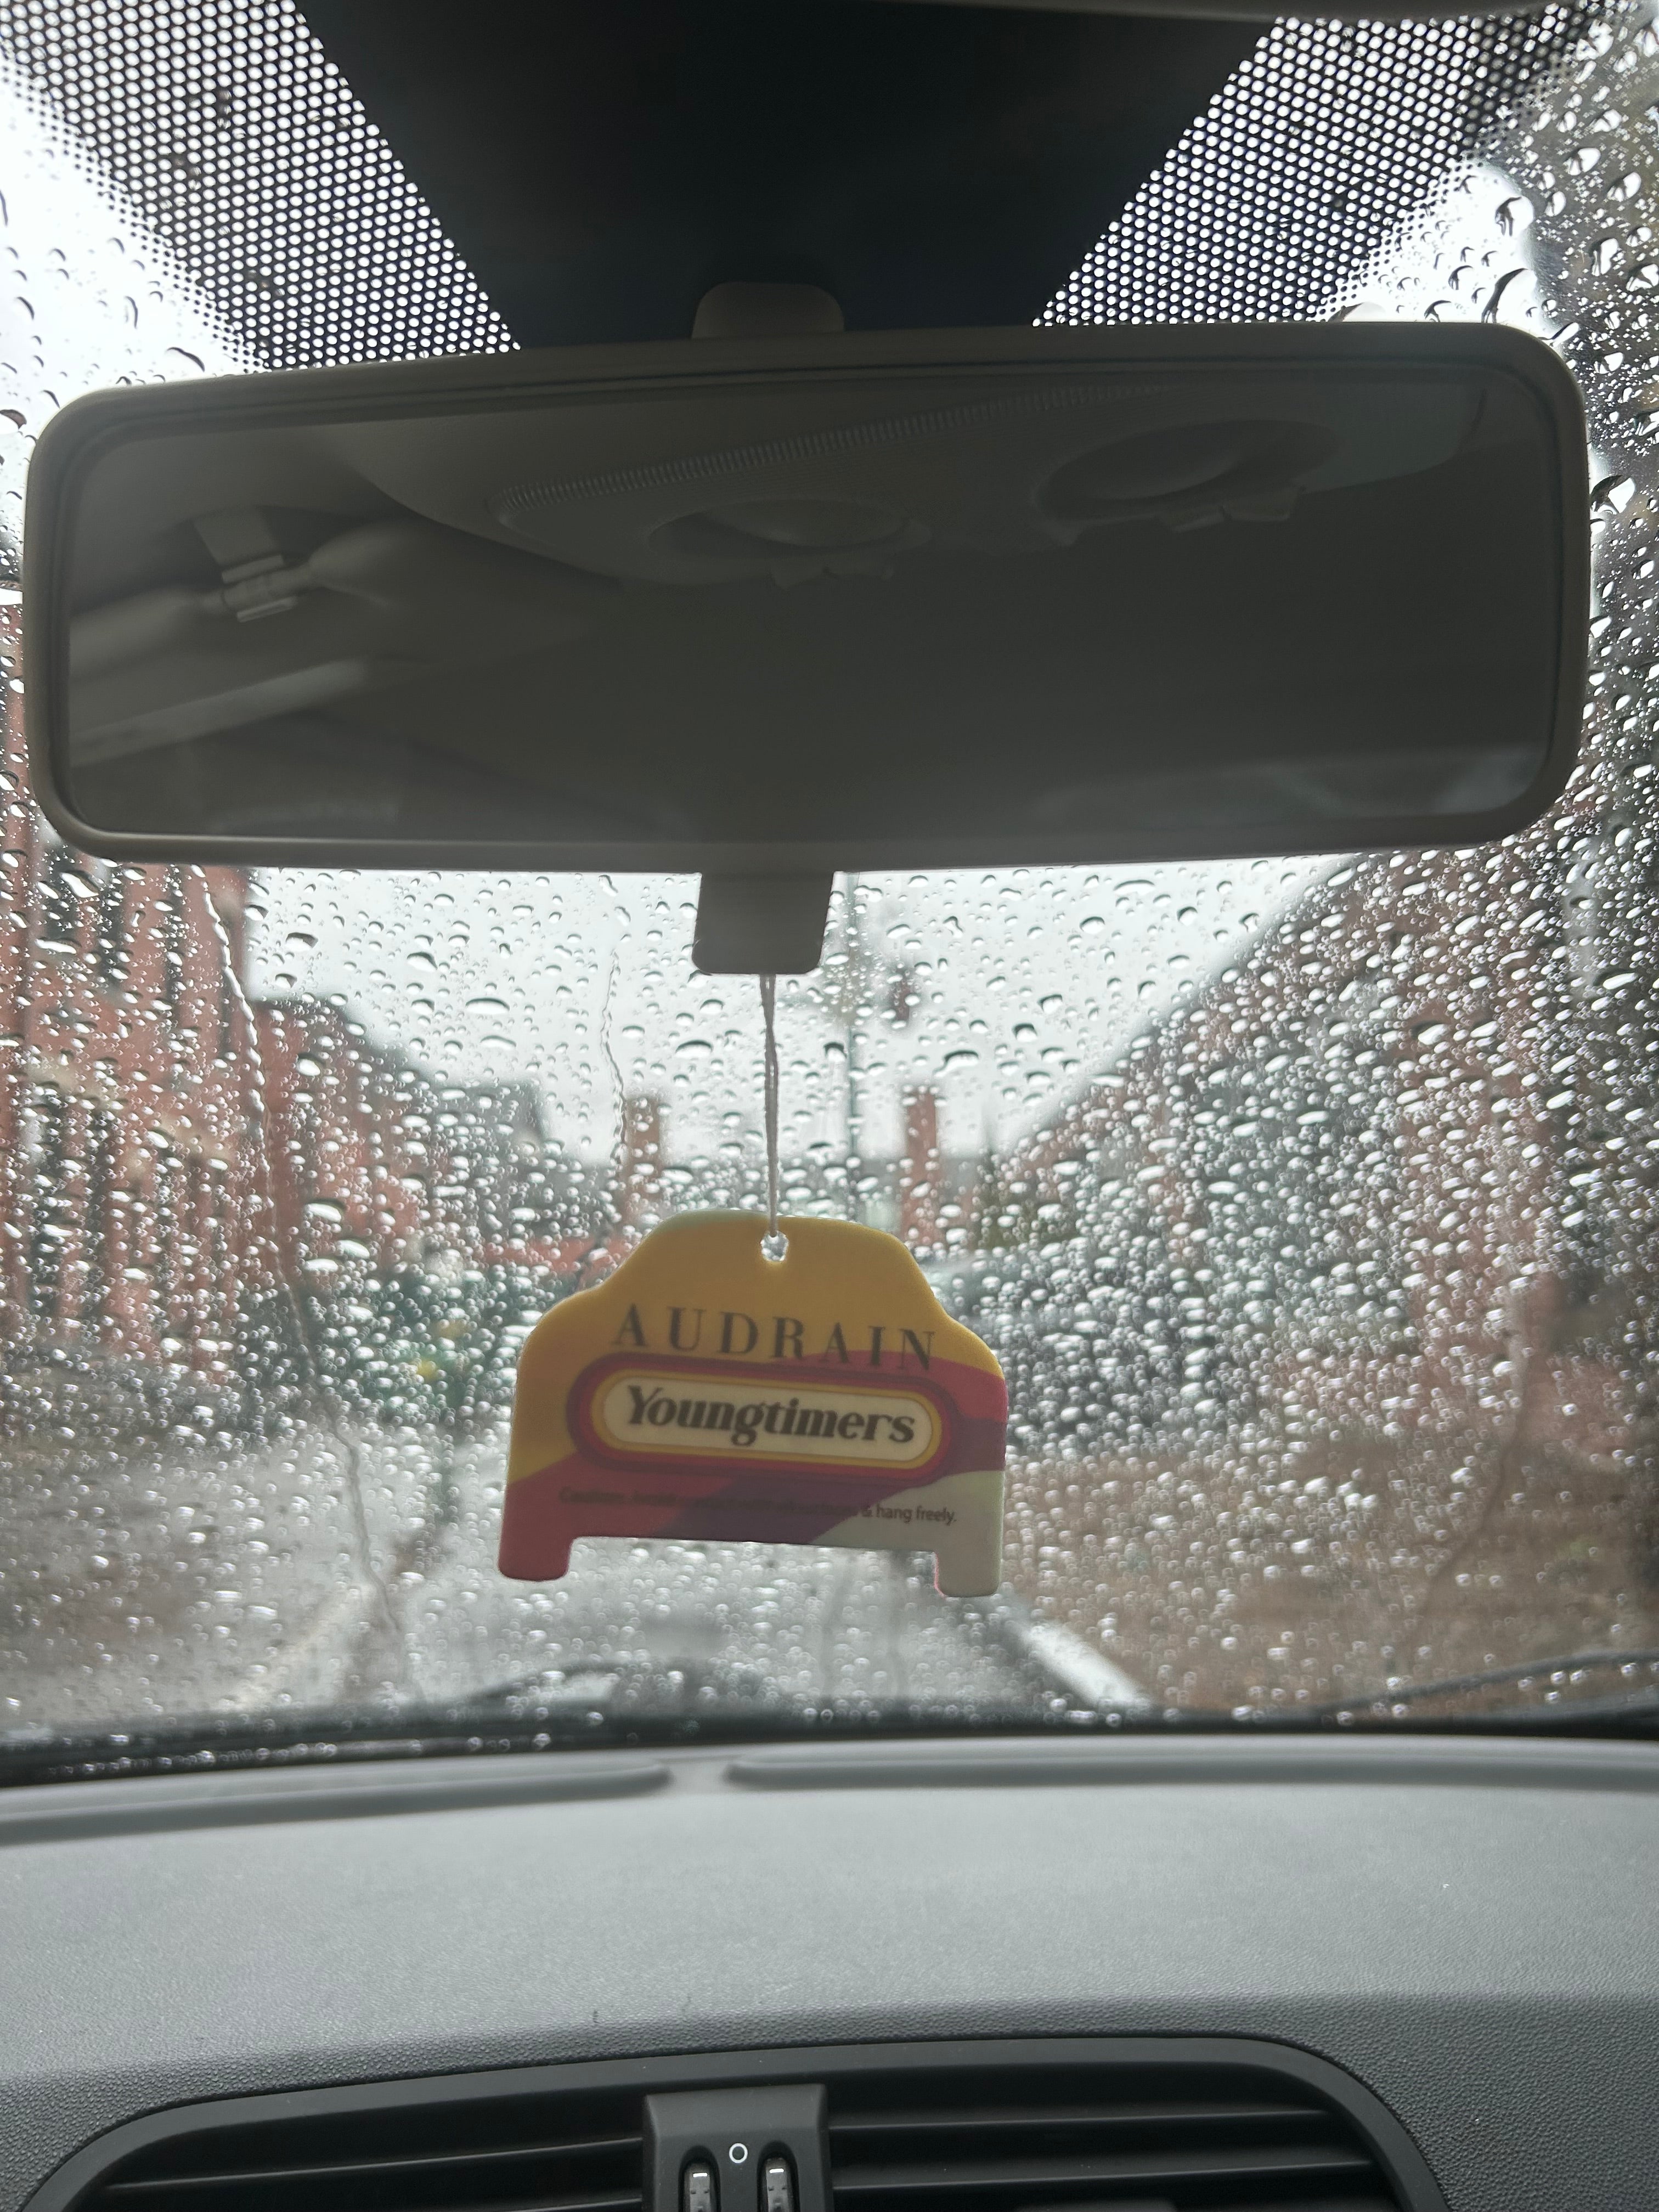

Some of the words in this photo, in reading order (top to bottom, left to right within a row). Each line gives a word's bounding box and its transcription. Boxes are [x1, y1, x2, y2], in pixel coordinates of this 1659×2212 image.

[612, 1303, 935, 1370] AUDRAIN
[627, 1385, 916, 1447] Youngtimers
[877, 1503, 912, 1523] hang
[916, 1505, 957, 1526] freely.
